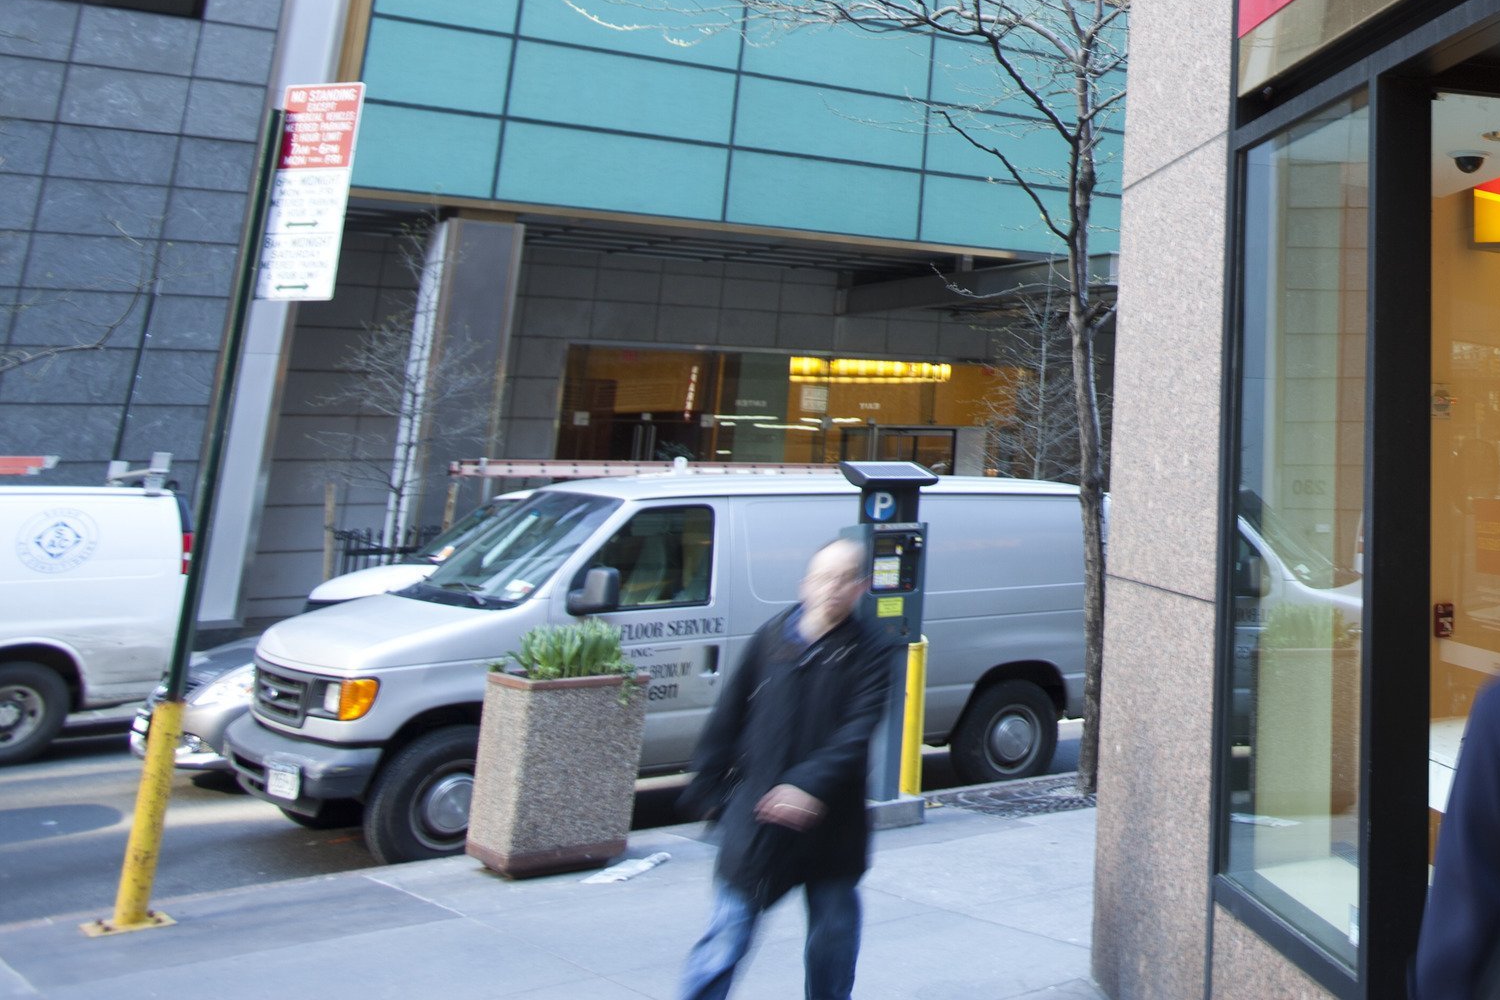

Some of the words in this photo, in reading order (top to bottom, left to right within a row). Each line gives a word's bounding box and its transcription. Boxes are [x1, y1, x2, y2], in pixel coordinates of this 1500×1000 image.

[290, 89, 308, 103] NO
[308, 87, 358, 102] STANDING
[620, 621, 664, 641] FLOOR
[667, 616, 724, 637] SERVICE
[630, 647, 654, 658] INC.
